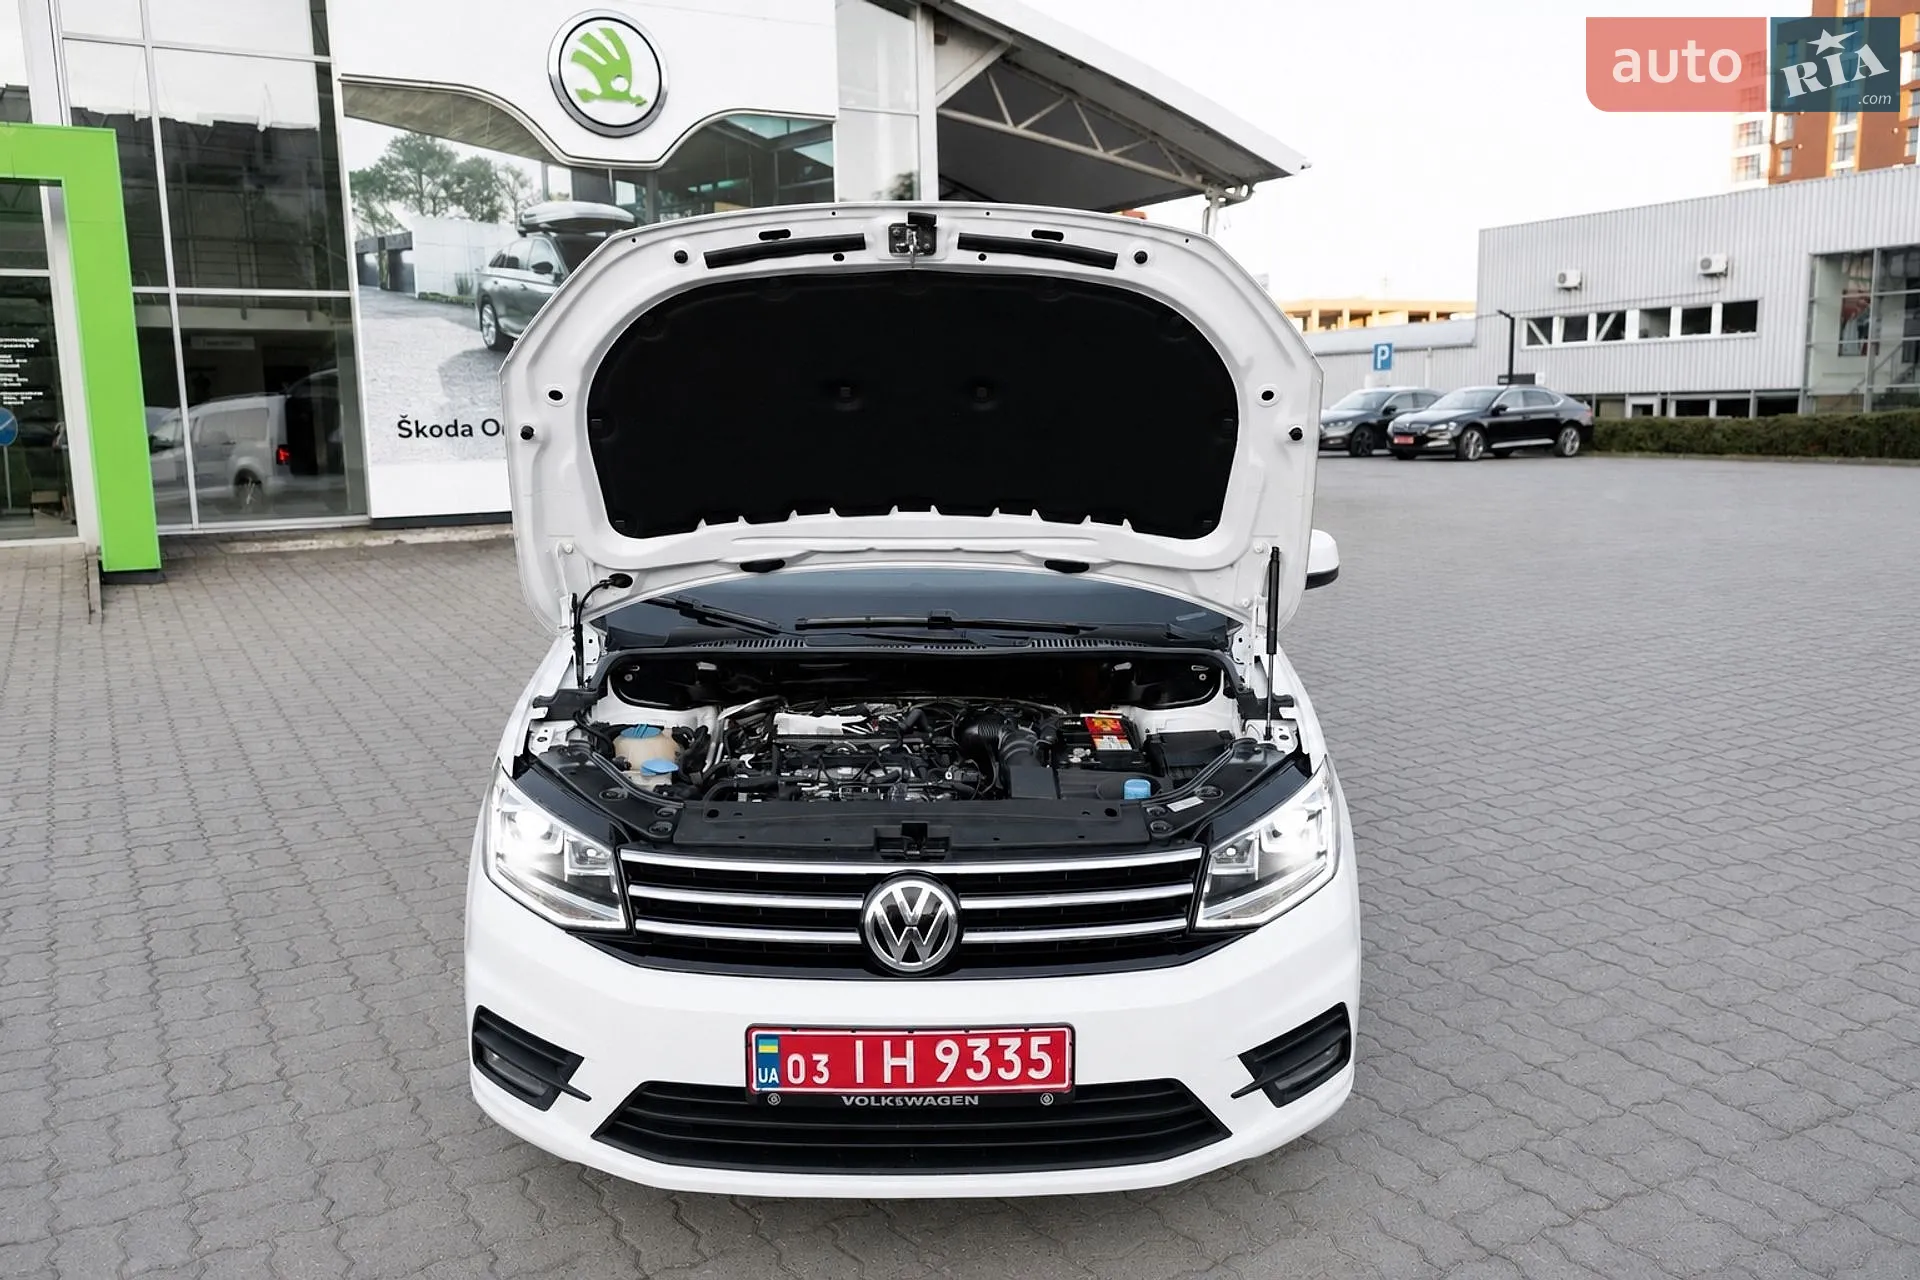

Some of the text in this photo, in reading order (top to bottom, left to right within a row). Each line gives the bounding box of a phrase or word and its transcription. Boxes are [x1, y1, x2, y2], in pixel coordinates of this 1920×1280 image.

[1376, 346, 1389, 369] P
[397, 414, 505, 439] Škoda O
[786, 1036, 1053, 1085] 03 IH 9335
[758, 1067, 779, 1084] UA
[841, 1095, 980, 1107] VOLKSWAGEN
